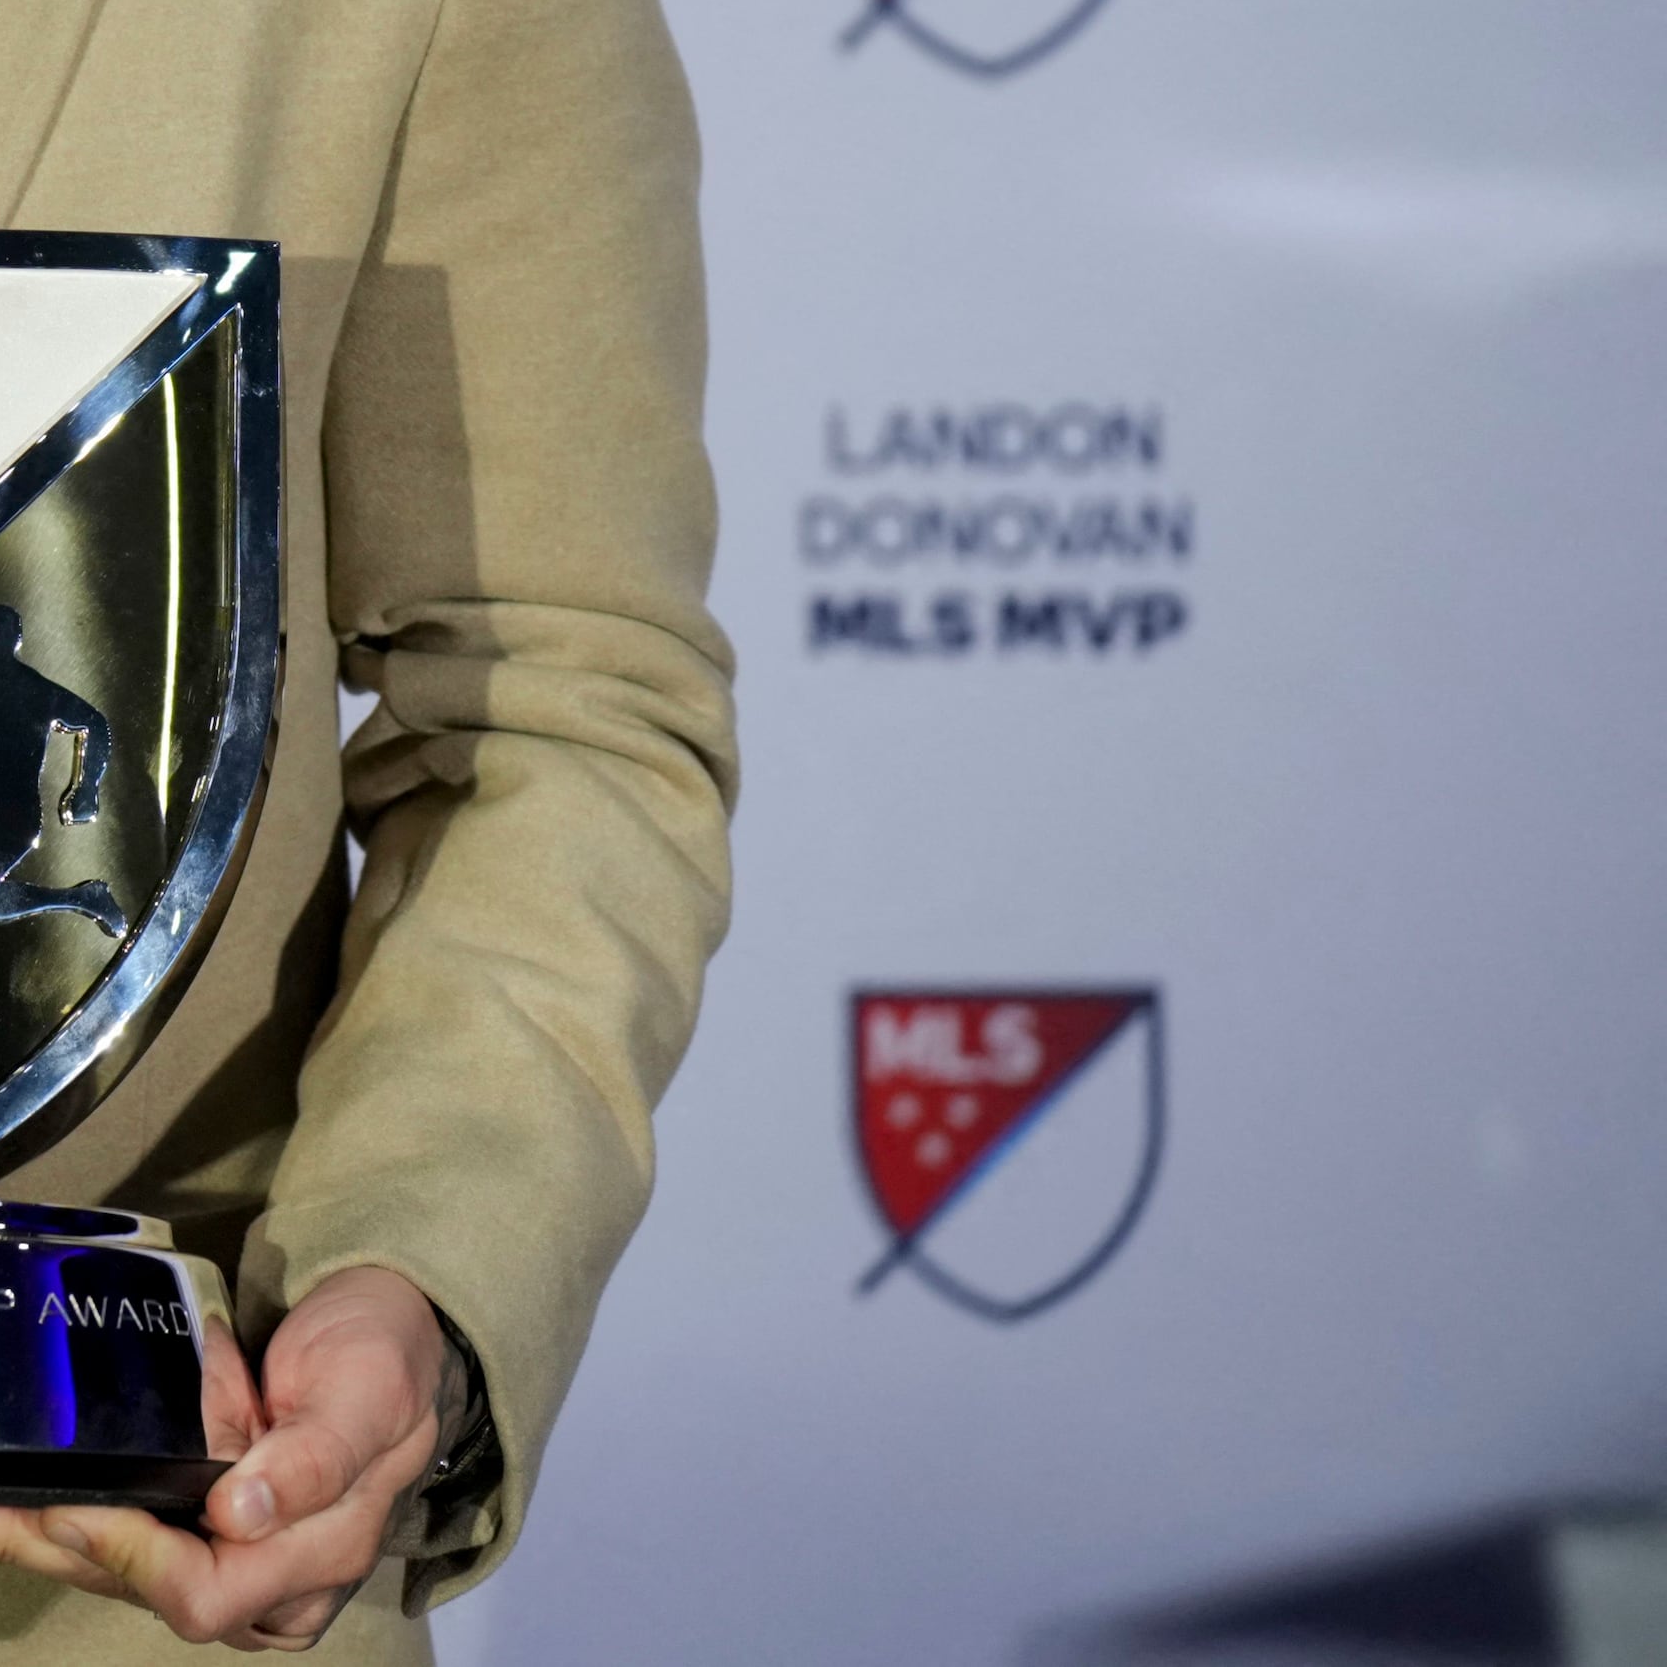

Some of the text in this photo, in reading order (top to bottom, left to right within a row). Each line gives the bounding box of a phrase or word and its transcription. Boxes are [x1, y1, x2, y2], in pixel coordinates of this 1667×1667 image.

[823, 404, 1163, 473] LANDON
[798, 497, 1194, 566] DONOVAN
[806, 586, 1189, 655] MLS MVP
[866, 1003, 1043, 1084] MLS
[38, 1291, 190, 1336] AWARD
